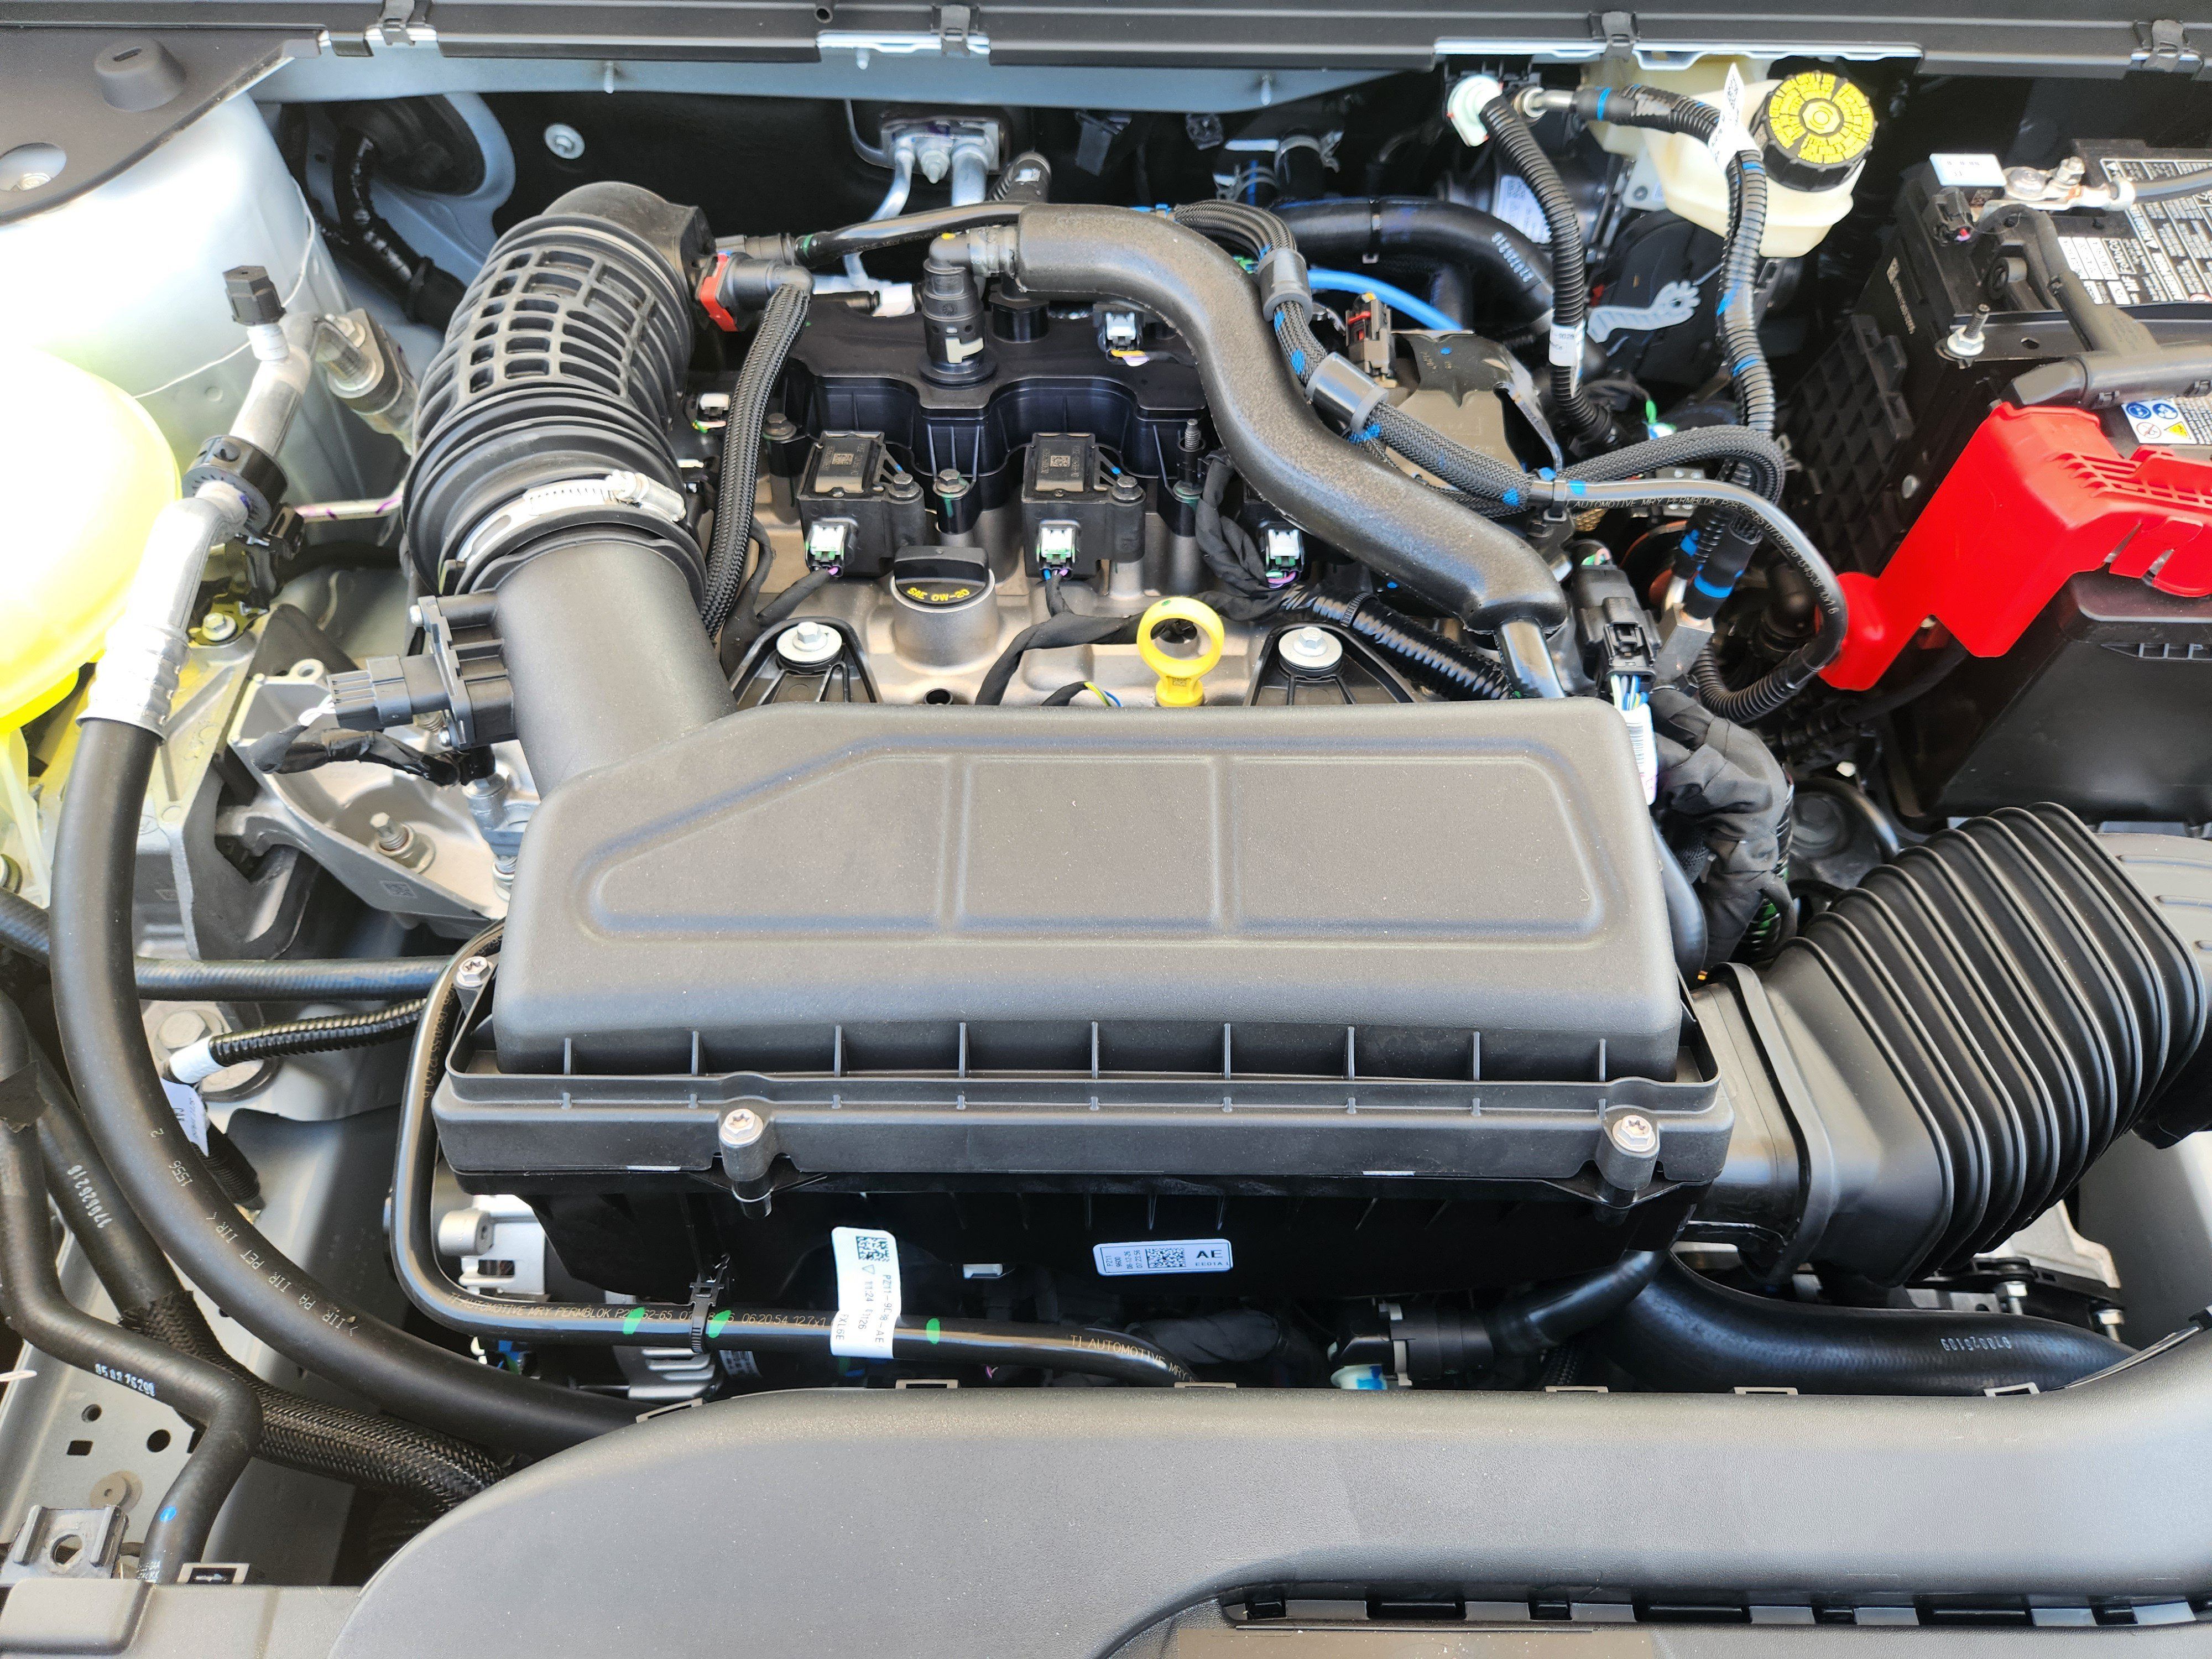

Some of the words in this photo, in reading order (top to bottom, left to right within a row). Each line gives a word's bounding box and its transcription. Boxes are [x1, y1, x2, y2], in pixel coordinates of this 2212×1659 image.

[1572, 499, 1636, 509] AUTOMOTIVE
[1640, 498, 1663, 507] MRY
[1666, 497, 1717, 505] PERMBLOK
[907, 587, 928, 600] SAE
[930, 588, 971, 601] 0W-20
[166, 1160, 192, 1188] 1556
[215, 1225, 239, 1243] IIR
[239, 1250, 262, 1270] PET
[1196, 1249, 1224, 1259] AE
[268, 1272, 291, 1292] IIR
[299, 1293, 316, 1311] PA
[459, 1297, 526, 1316] AUTOMOTIVE
[528, 1306, 553, 1317] MRY
[555, 1306, 612, 1318] PERMBLOK
[322, 1308, 346, 1333] IIR
[836, 1314, 849, 1340] FXL6E
[1071, 1334, 1082, 1348] TI
[1087, 1338, 1165, 1363] AUTOMOTIVE
[1168, 1361, 1188, 1381] MRY
